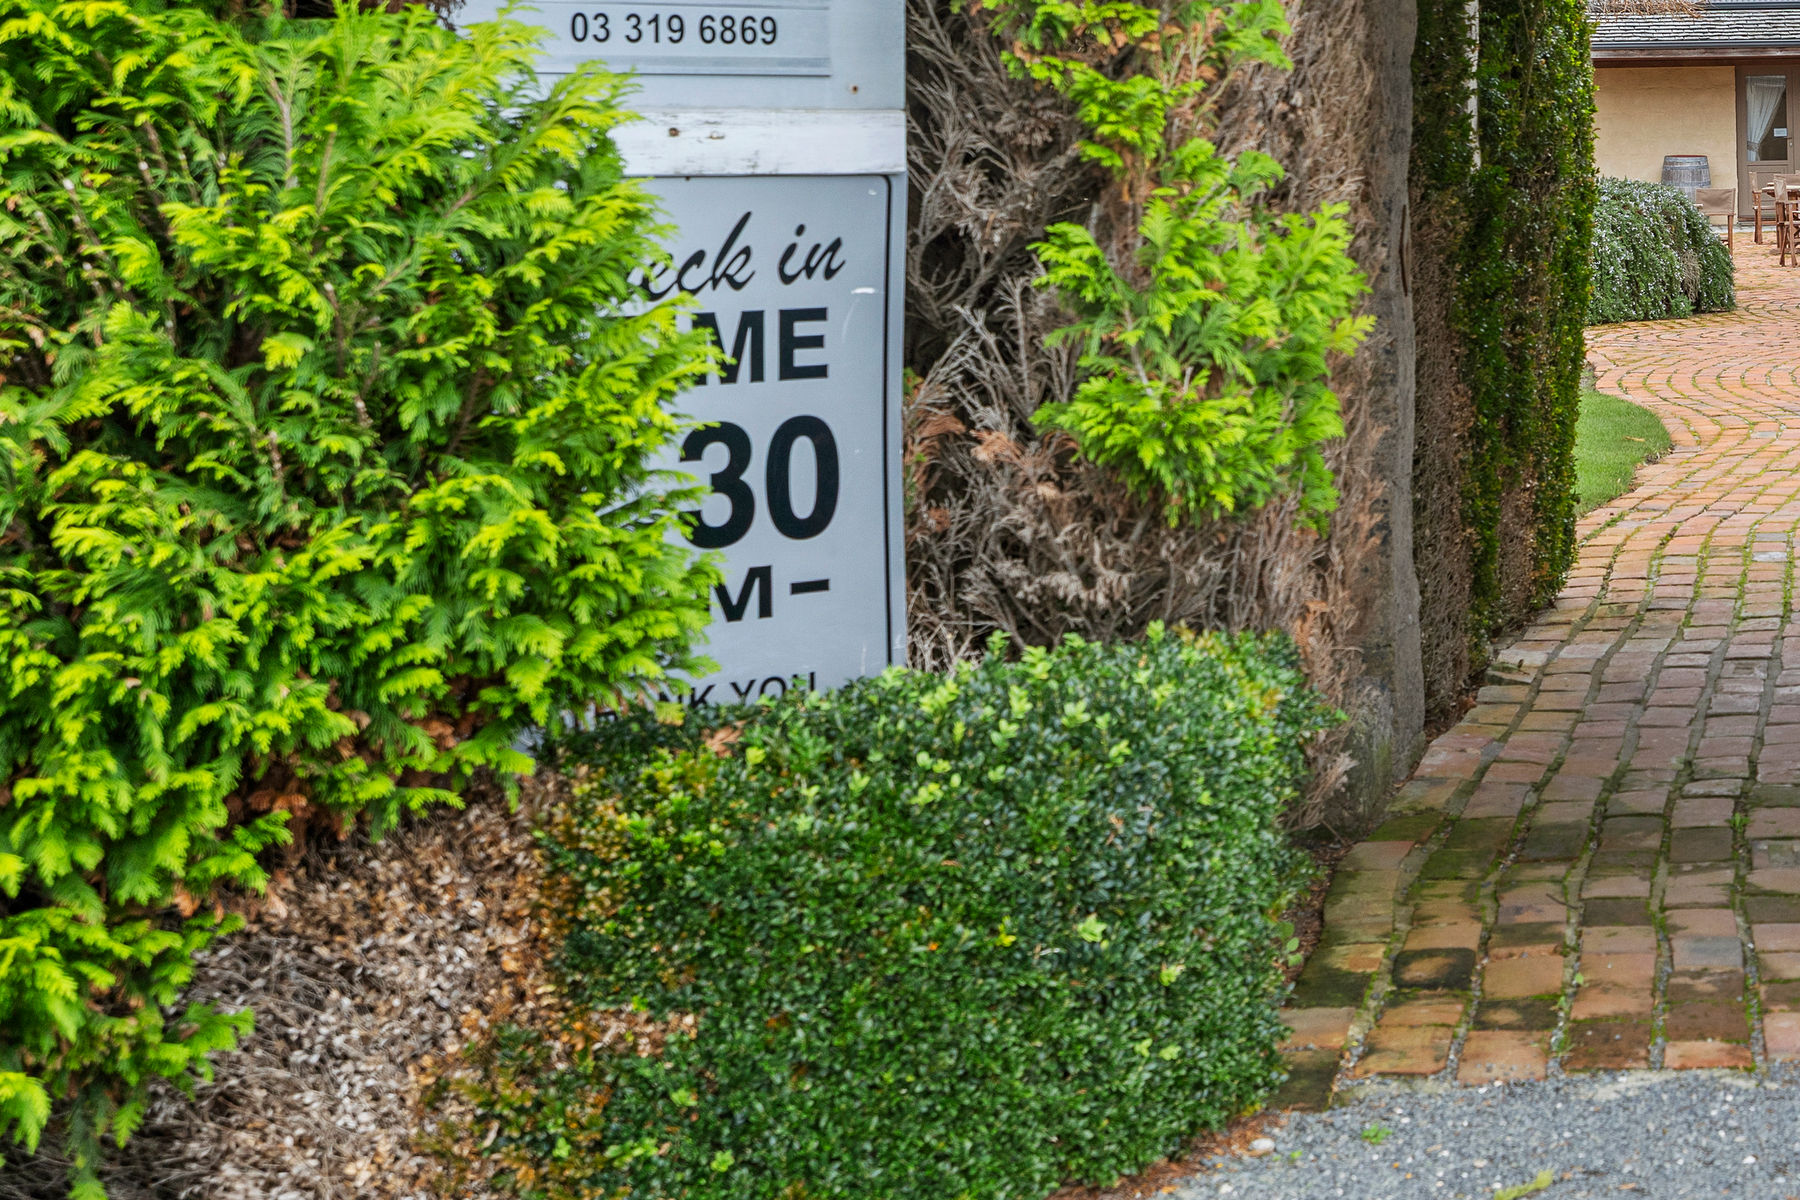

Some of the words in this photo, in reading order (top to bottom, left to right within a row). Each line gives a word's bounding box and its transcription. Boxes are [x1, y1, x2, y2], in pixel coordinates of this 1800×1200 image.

[570, 12, 610, 43] 03
[625, 13, 686, 44] 319
[700, 15, 778, 45] 6869
[638, 210, 756, 303] eck
[778, 223, 846, 285] in
[689, 306, 829, 386] ME
[679, 414, 841, 549] 30
